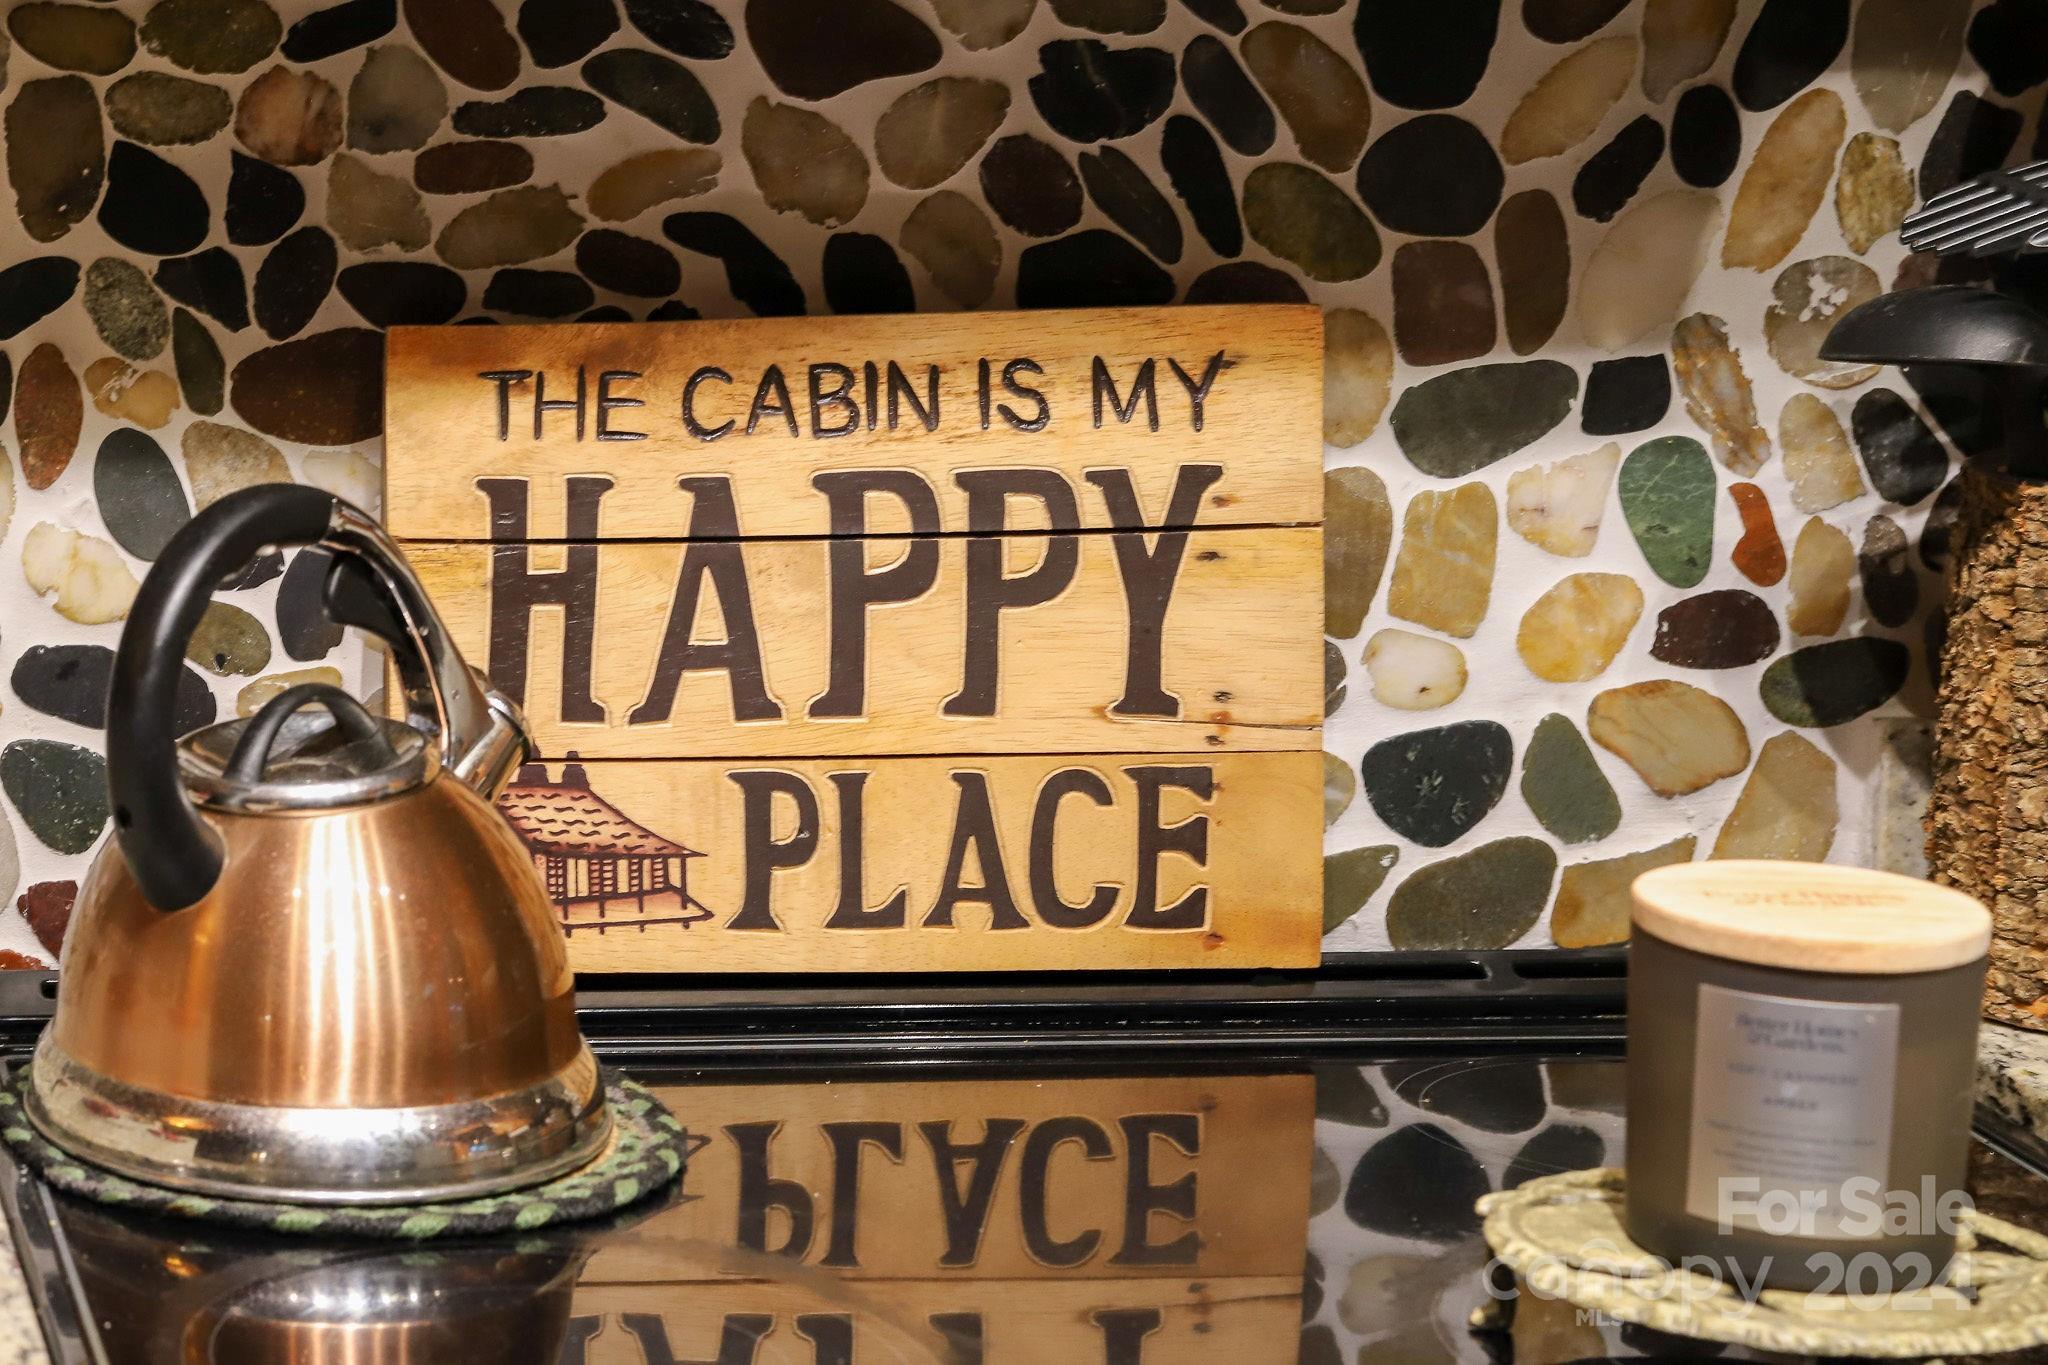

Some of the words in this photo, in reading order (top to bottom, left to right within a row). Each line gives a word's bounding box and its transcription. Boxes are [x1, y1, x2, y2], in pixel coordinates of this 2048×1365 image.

[477, 366, 650, 442] THE
[681, 359, 941, 442] CABIN
[978, 356, 1051, 434] IS
[1090, 350, 1232, 433] MY
[473, 464, 1225, 724] HAPPY
[726, 765, 1217, 932] PLACE
